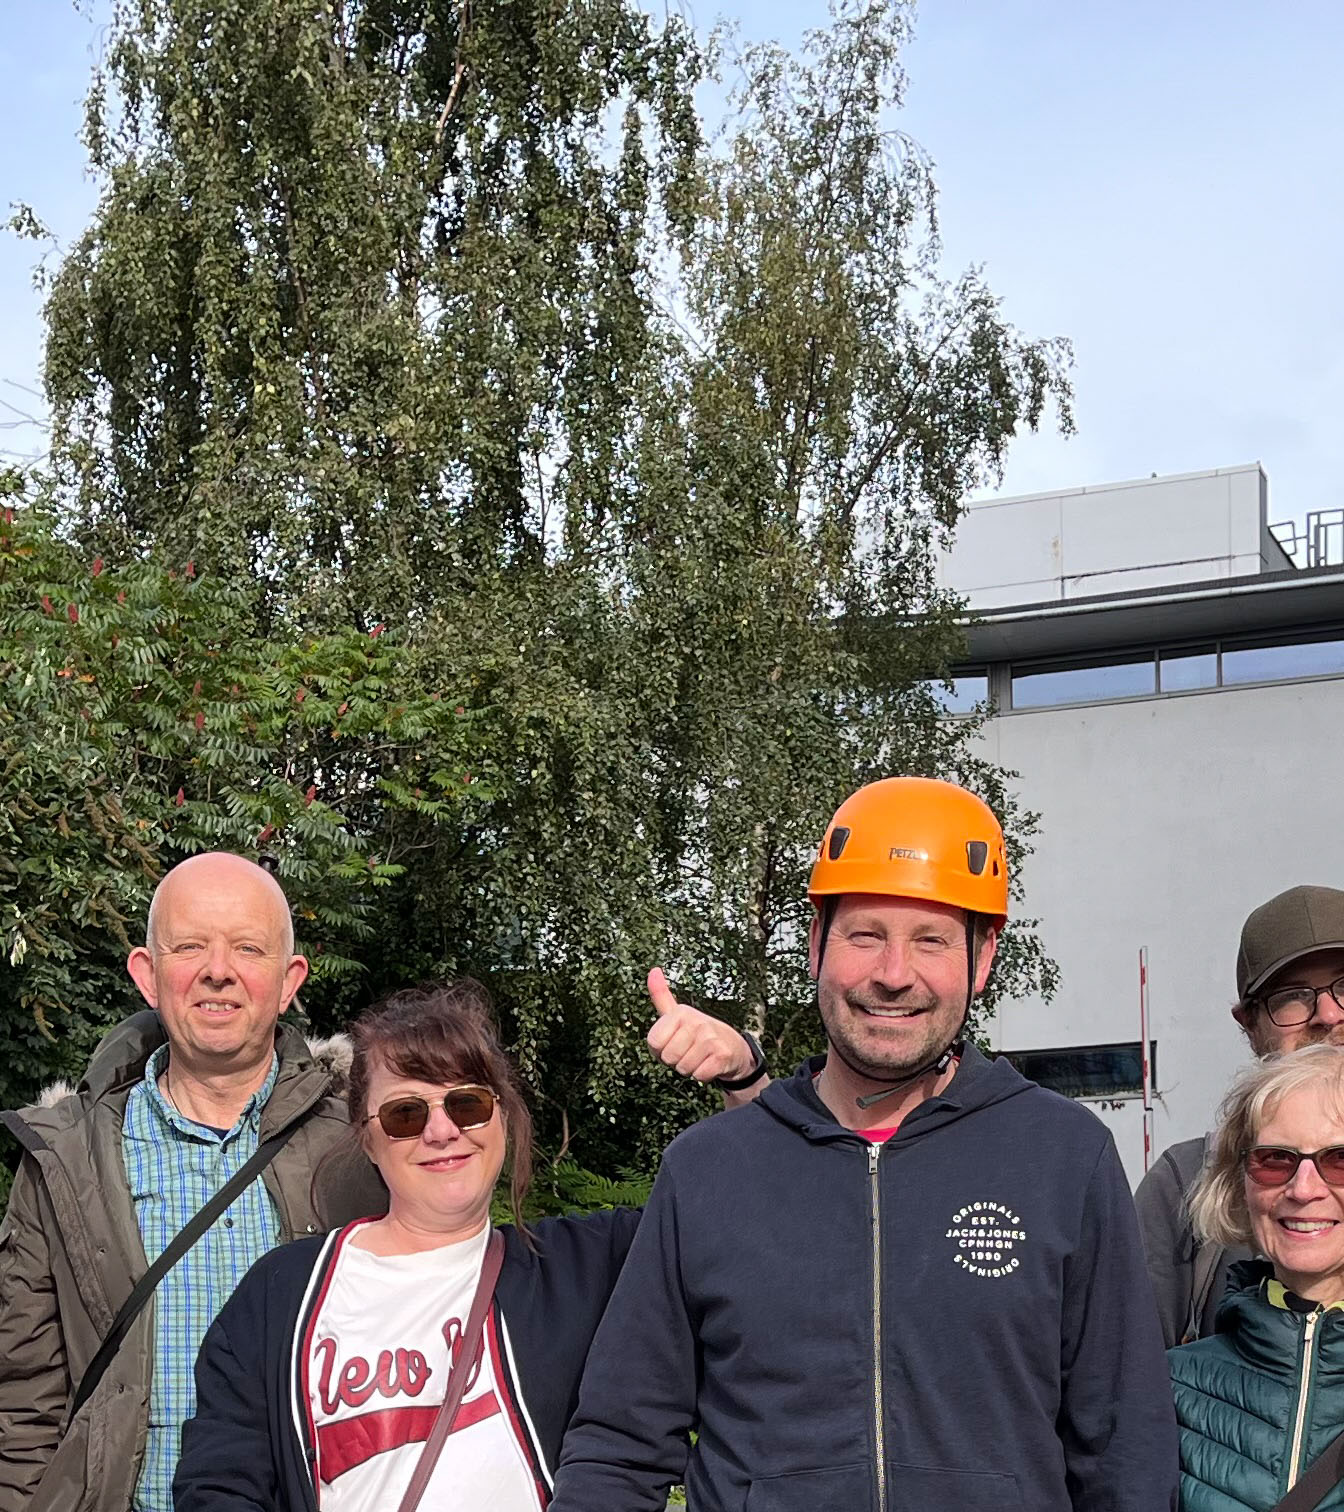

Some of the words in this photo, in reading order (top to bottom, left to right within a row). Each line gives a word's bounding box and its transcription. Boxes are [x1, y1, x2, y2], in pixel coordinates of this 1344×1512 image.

[889, 847, 926, 861] PETZL
[952, 1202, 1020, 1225] ORIGINALS
[971, 1216, 1000, 1226] EST.
[970, 1251, 1002, 1262] 1990
[953, 1254, 1020, 1278] ORIGINALS
